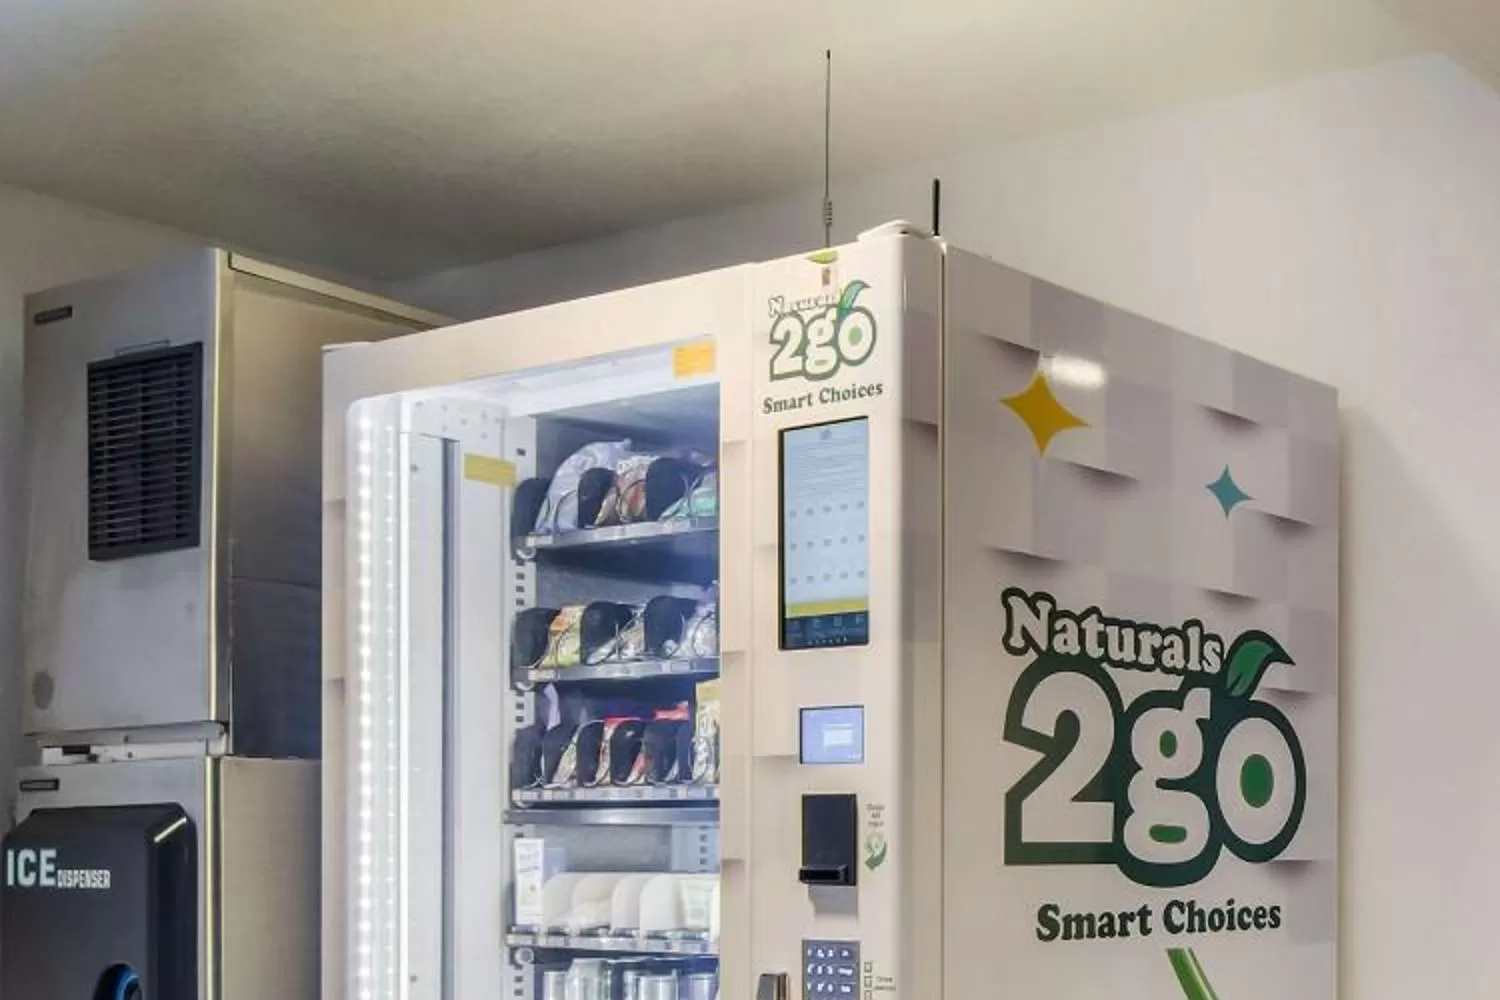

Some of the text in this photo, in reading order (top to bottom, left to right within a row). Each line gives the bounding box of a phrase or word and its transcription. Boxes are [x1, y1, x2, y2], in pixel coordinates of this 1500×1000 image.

[769, 303, 877, 382] 2go
[762, 382, 884, 415] Smart Choices
[1001, 587, 1225, 676] Naturals
[1003, 654, 1307, 888] 2go
[7, 847, 111, 889] ICE DISPENSER
[1035, 898, 1282, 943] Smart Choices
